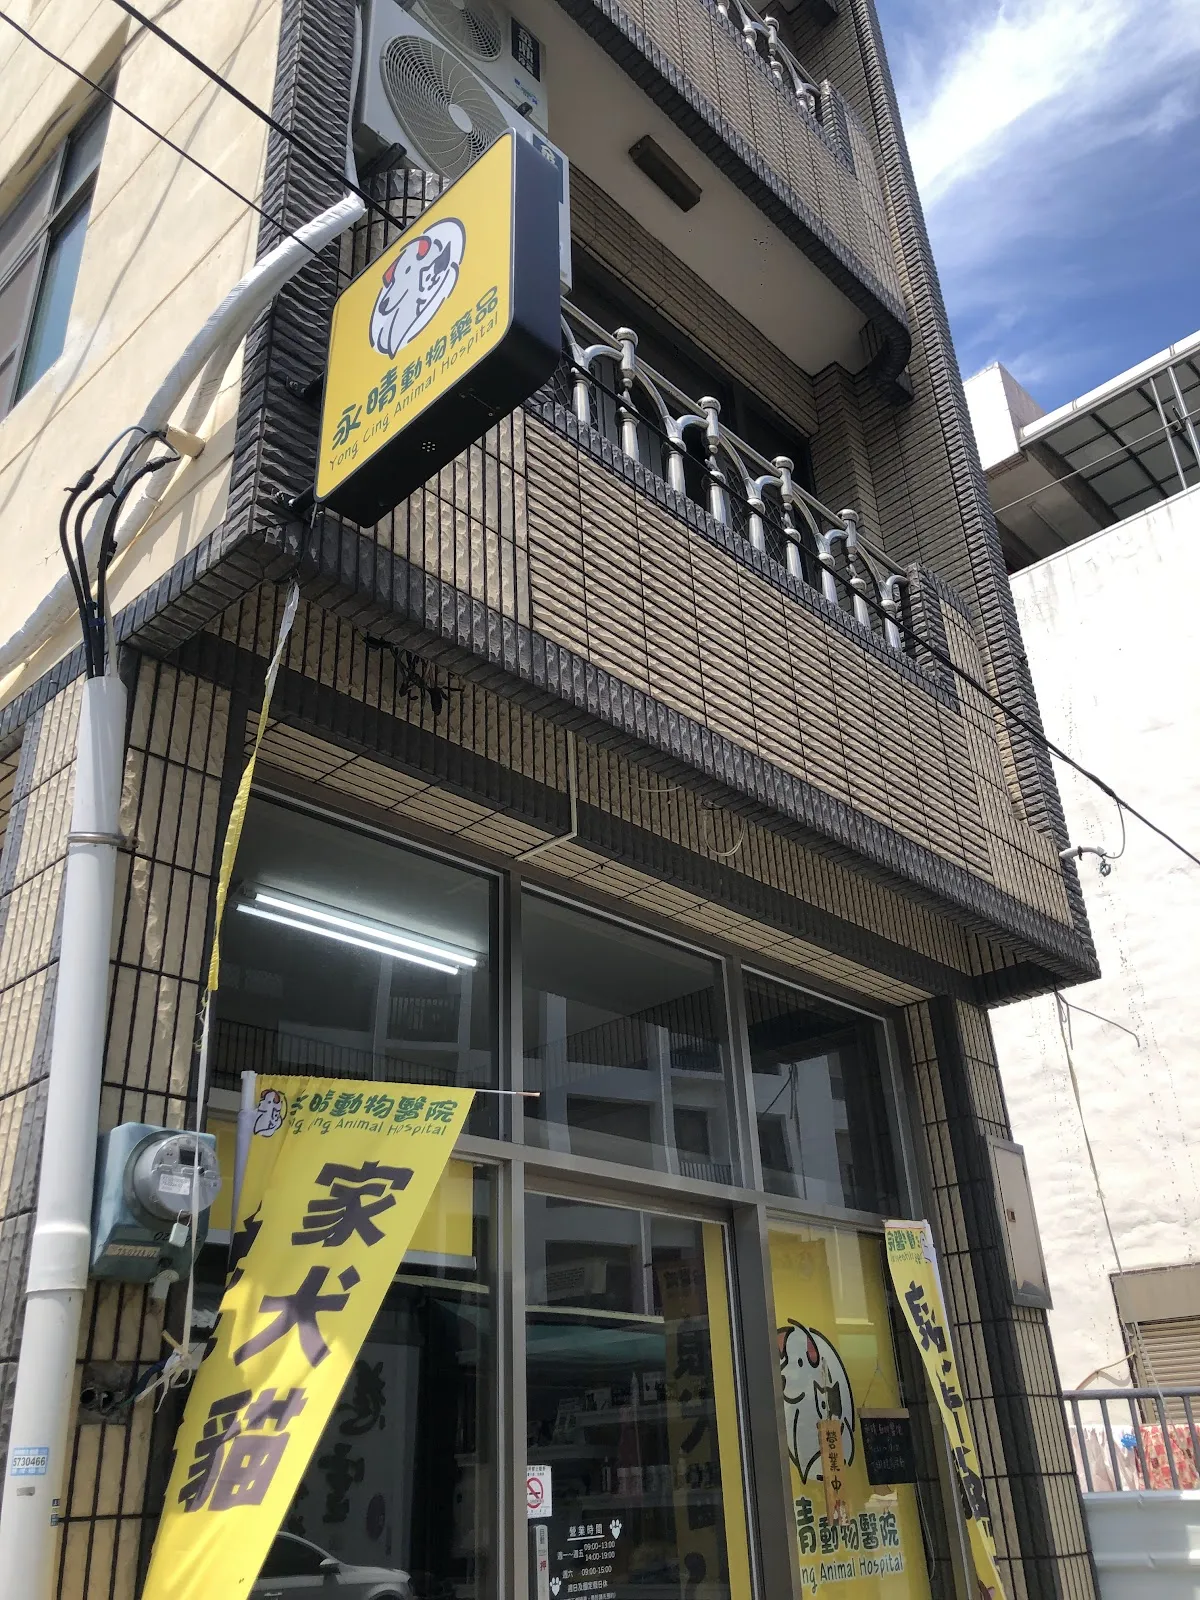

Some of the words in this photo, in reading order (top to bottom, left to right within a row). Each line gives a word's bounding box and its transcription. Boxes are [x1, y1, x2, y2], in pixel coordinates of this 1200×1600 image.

[331, 285, 498, 451] 永晴動物藥品
[329, 441, 359, 471] Yong
[362, 414, 390, 443] Cing
[393, 370, 436, 417] Animal
[441, 312, 498, 374] Hospital
[335, 1117, 384, 1134] Animal
[387, 1123, 447, 1137] Hospital
[13, 1456, 46, 1467] 5730466
[826, 1430, 842, 1493] 營業中
[569, 1523, 603, 1537] 營業時間
[583, 1541, 616, 1551] 09:00-13:00
[820, 1558, 856, 1582] Animal
[859, 1552, 904, 1579] Hospital
